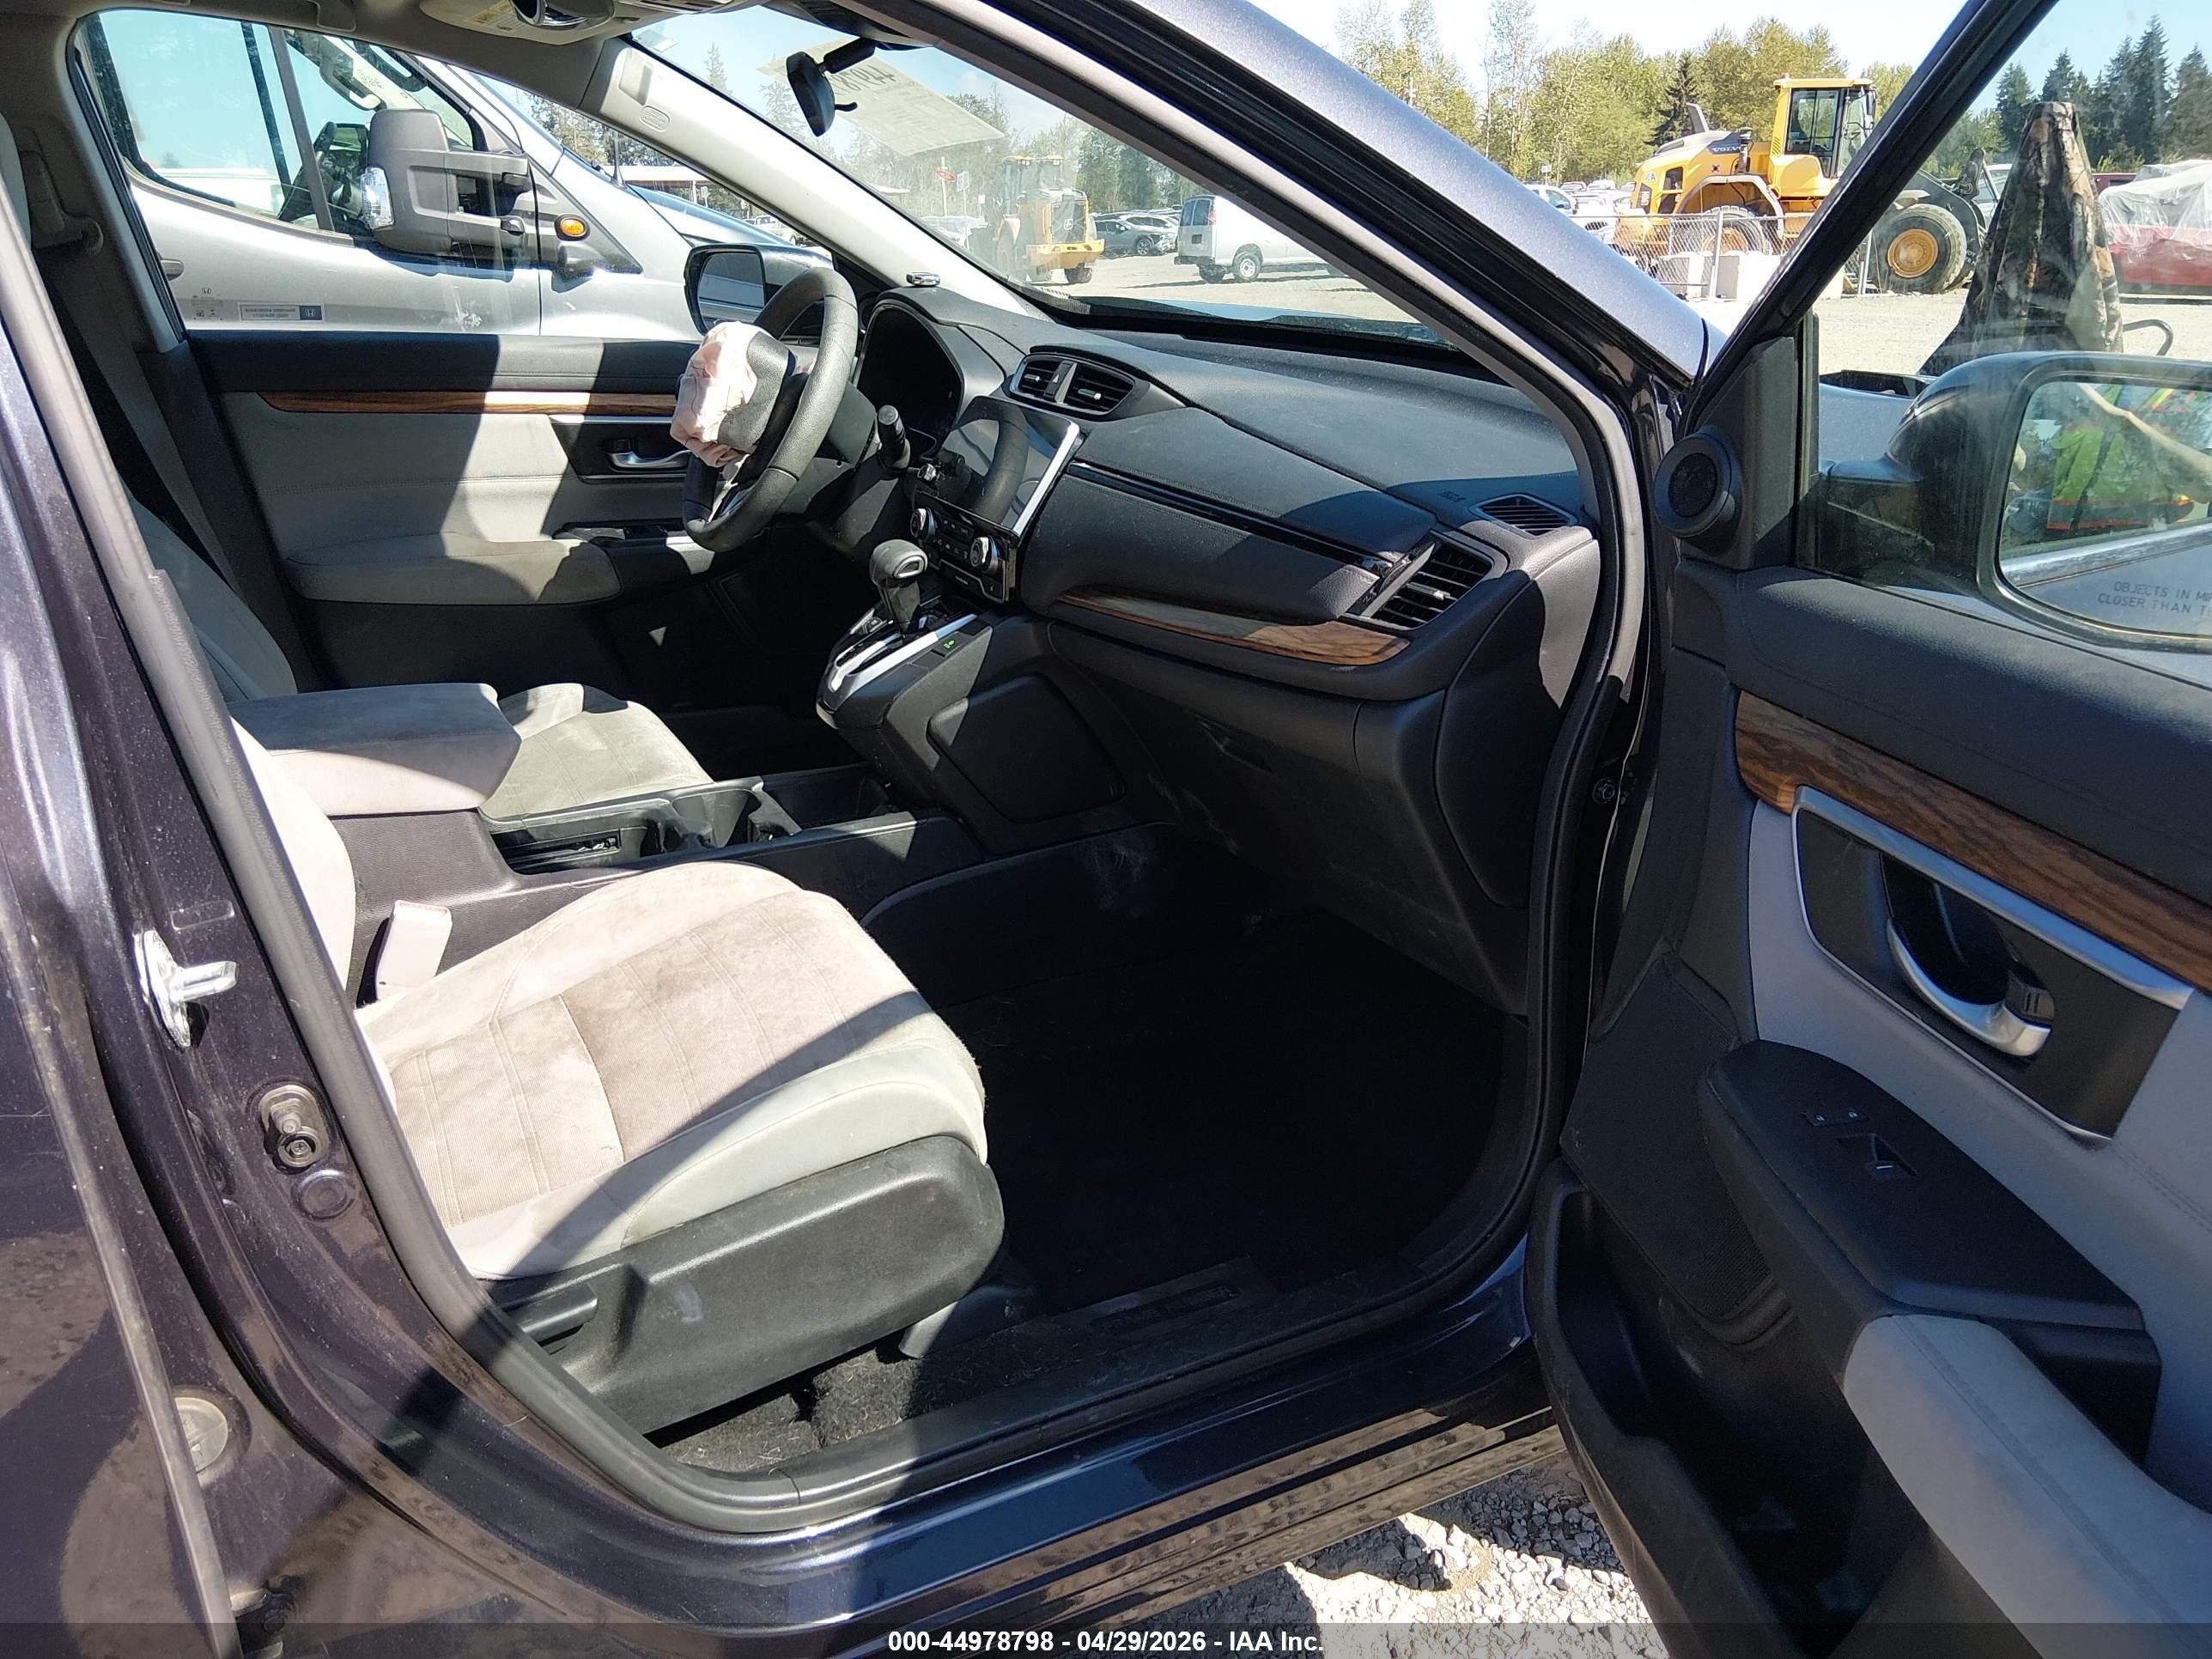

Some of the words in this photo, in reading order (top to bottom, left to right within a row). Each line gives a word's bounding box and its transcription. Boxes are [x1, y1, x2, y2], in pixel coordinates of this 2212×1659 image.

[2114, 581, 2168, 598] OBJECTS
[2175, 589, 2191, 600] IN
[2098, 592, 2145, 608] CLOSER
[2151, 599, 2192, 613] THAN
